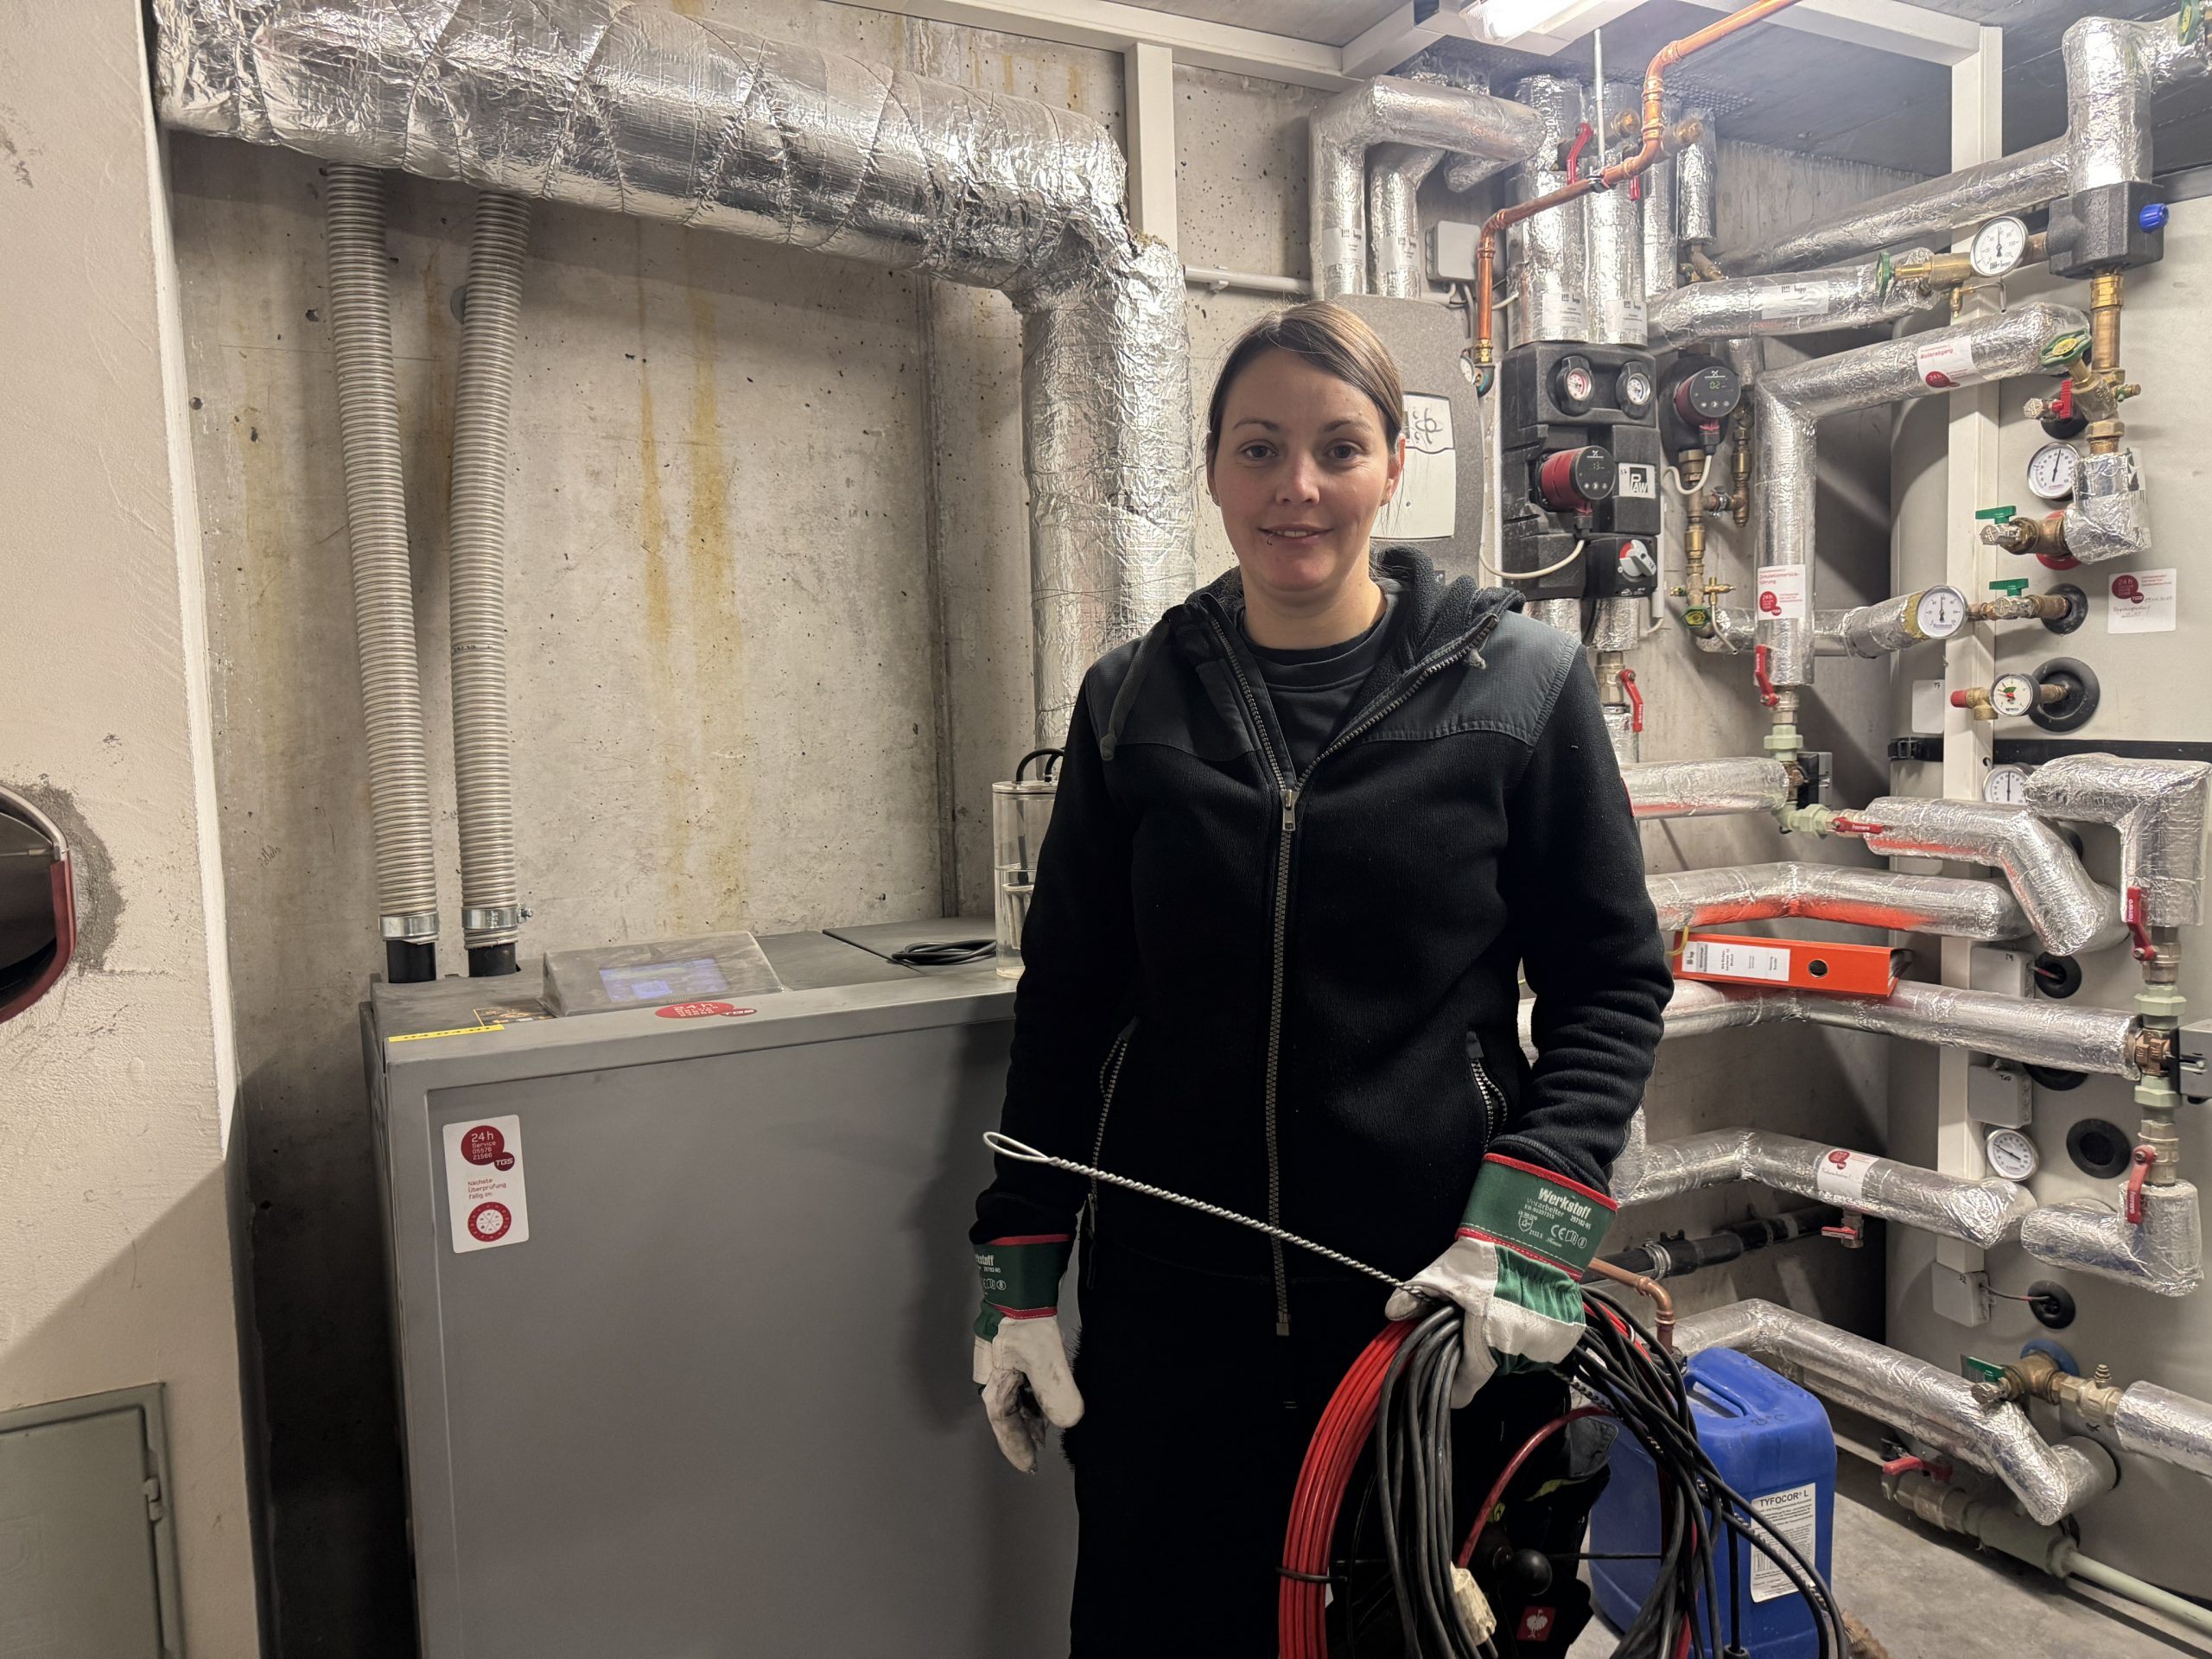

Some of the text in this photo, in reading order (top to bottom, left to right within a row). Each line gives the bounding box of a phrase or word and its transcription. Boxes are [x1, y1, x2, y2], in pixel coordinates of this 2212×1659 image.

[1630, 473, 1648, 493] PAW
[471, 1131, 494, 1143] 24 h
[472, 1140, 496, 1149] Service
[496, 1158, 513, 1166] TGS
[468, 1178, 493, 1186] Nächste
[468, 1182, 506, 1193] Überprüfung
[1538, 1188, 1592, 1219] Werkstoff
